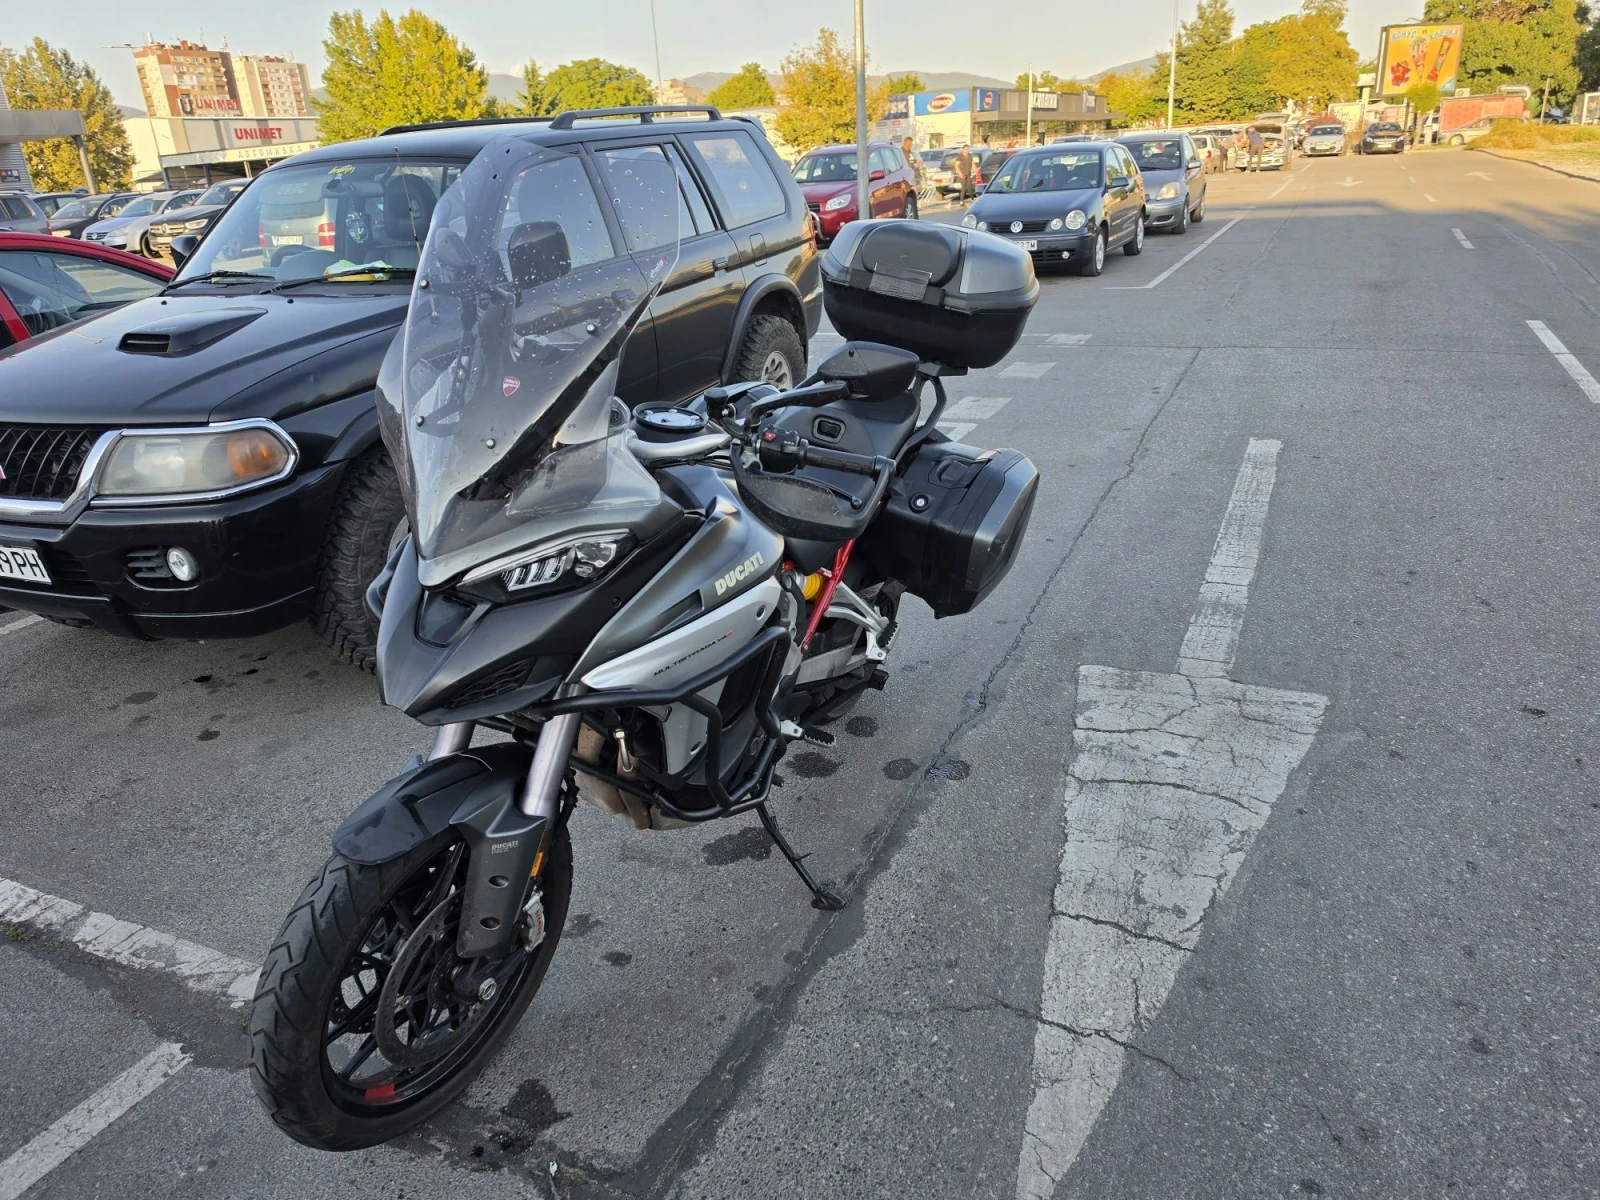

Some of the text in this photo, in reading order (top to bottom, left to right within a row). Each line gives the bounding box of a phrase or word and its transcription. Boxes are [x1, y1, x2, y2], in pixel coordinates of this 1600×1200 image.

[195, 97, 240, 110] UNIMET
[234, 127, 282, 140] UNIMET
[238, 145, 302, 159] АВТОМИВКА
[714, 551, 764, 596] DUCATI
[653, 641, 716, 677] MULTISTRADA
[491, 840, 519, 849] DUCATI
